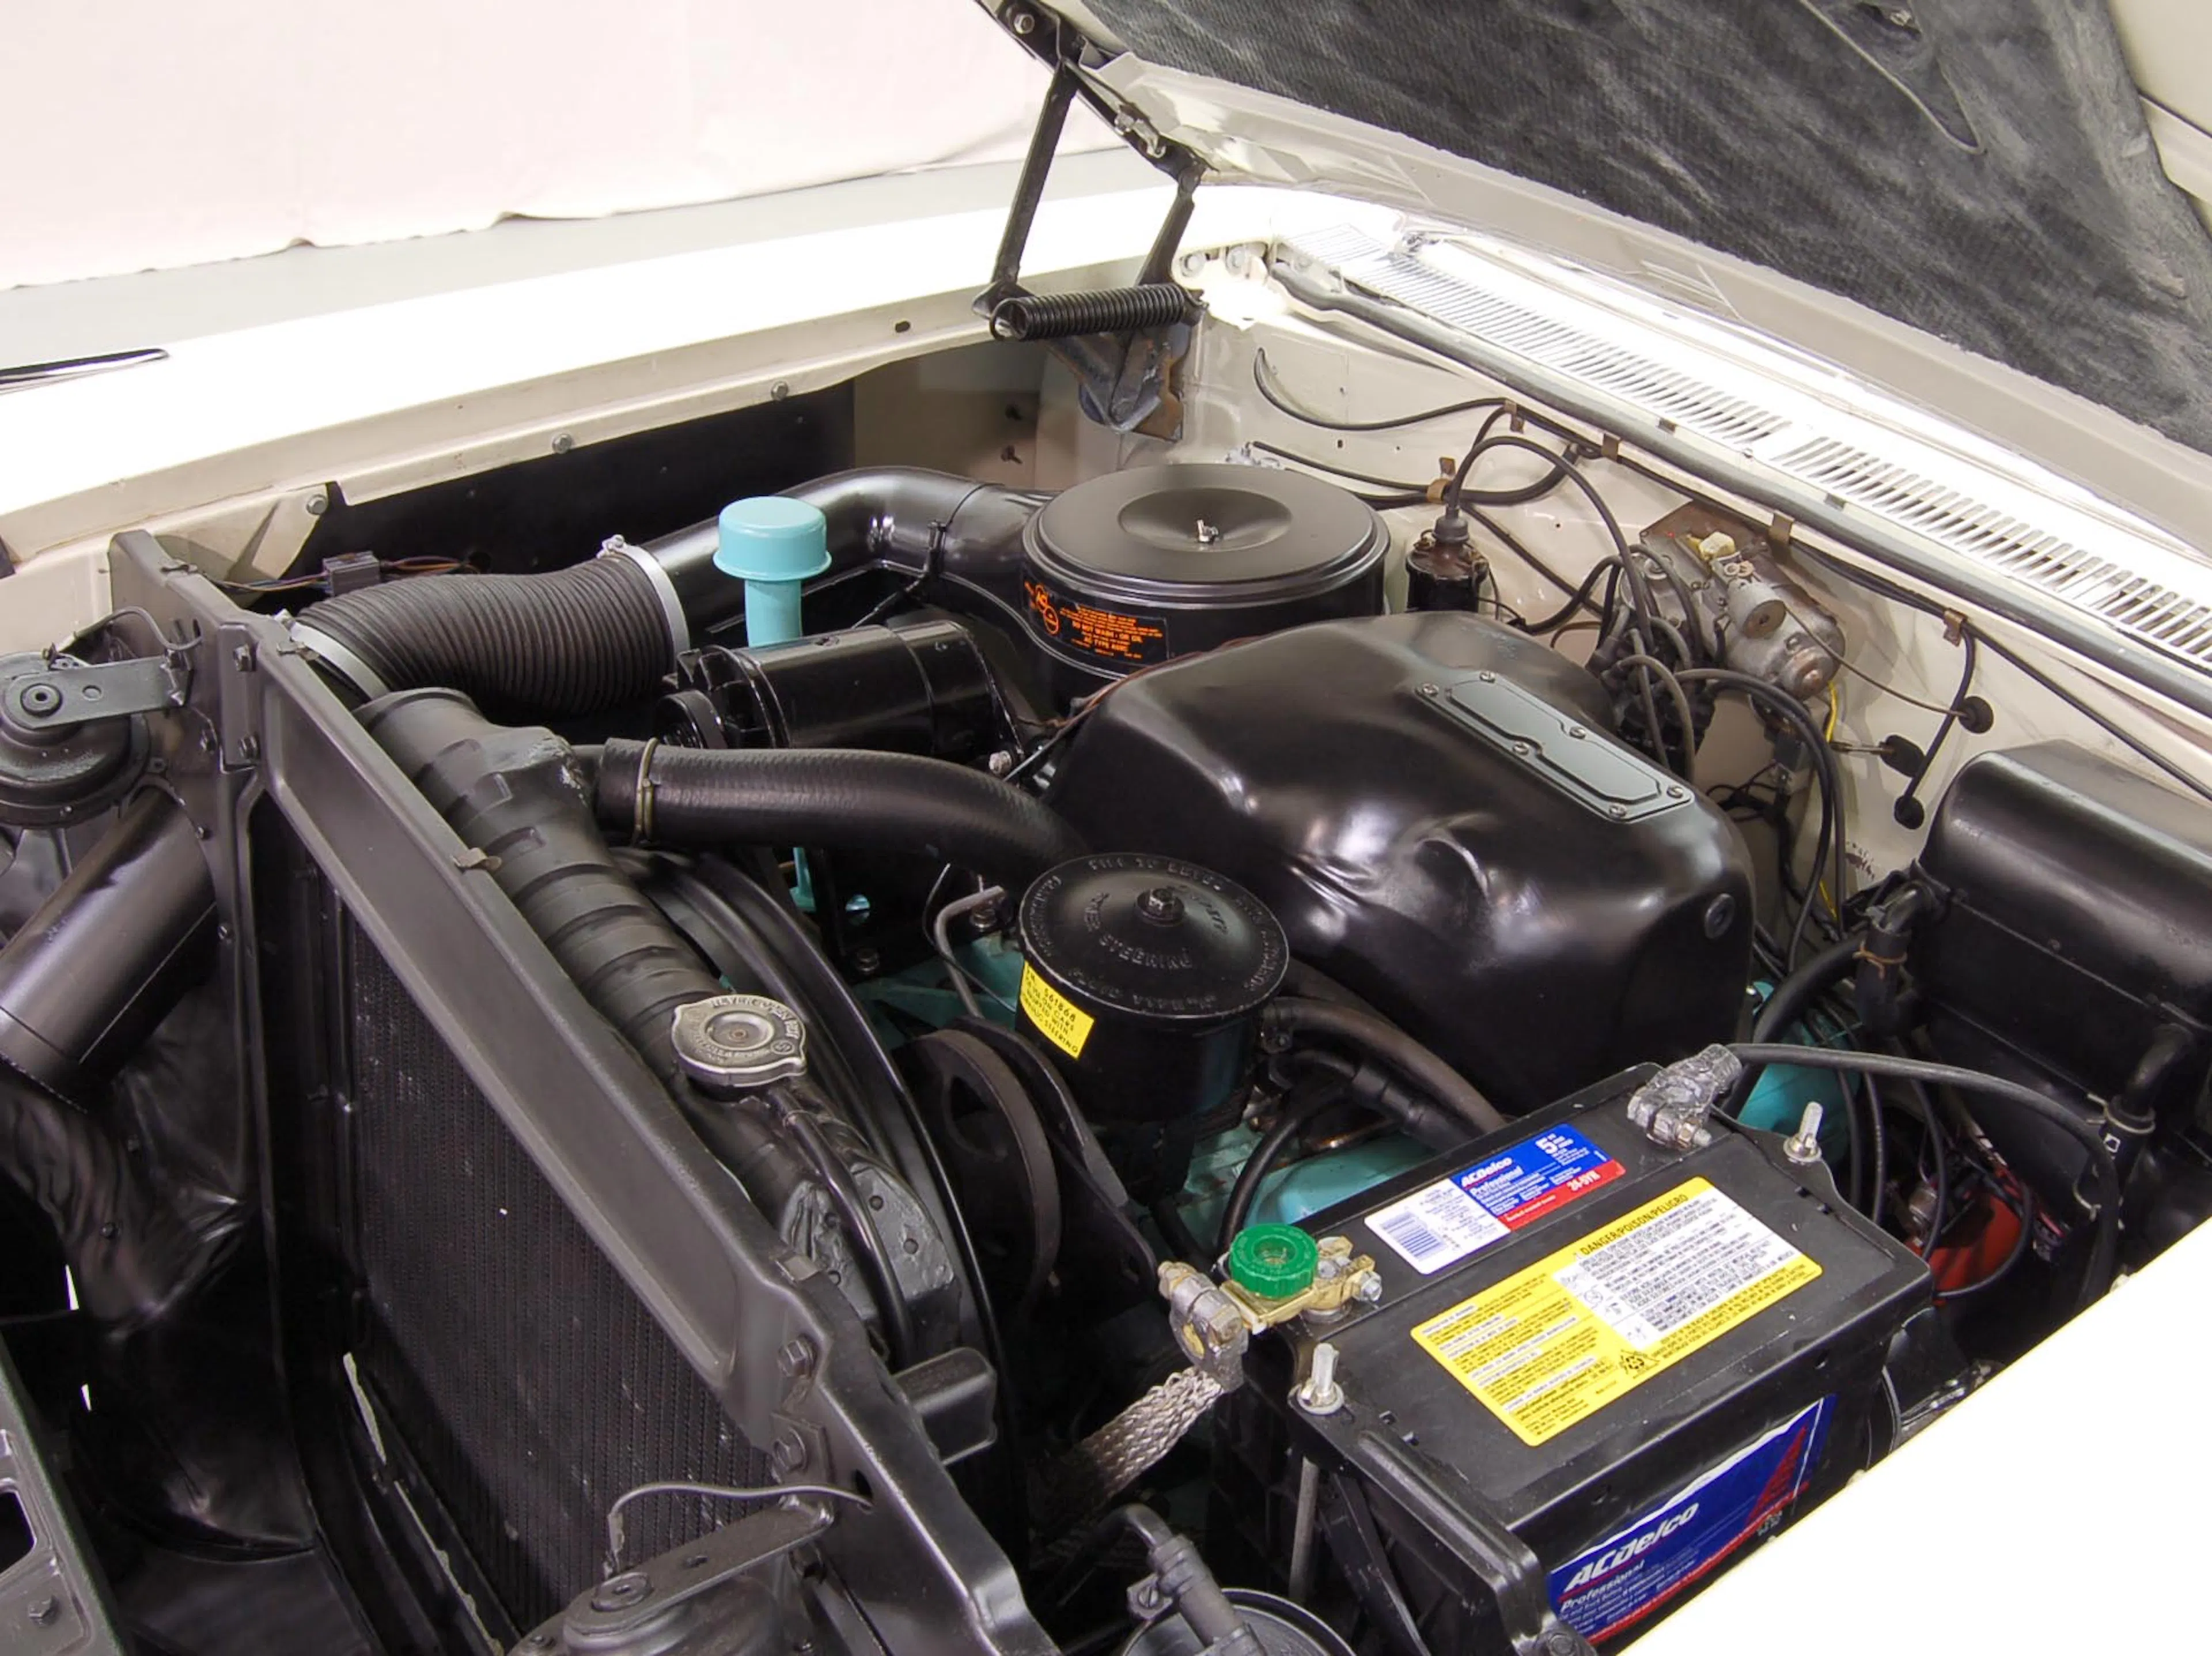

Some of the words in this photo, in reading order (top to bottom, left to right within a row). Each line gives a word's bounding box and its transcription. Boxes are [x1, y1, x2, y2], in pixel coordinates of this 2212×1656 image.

[1461, 1156, 1513, 1188] ACDelco
[1535, 1137, 1558, 1155] 5
[1580, 1194, 1688, 1256] DANGER/POISON/PELIGRO
[1564, 1502, 1699, 1593] ACDelco
[1560, 1559, 1646, 1614] Professional
